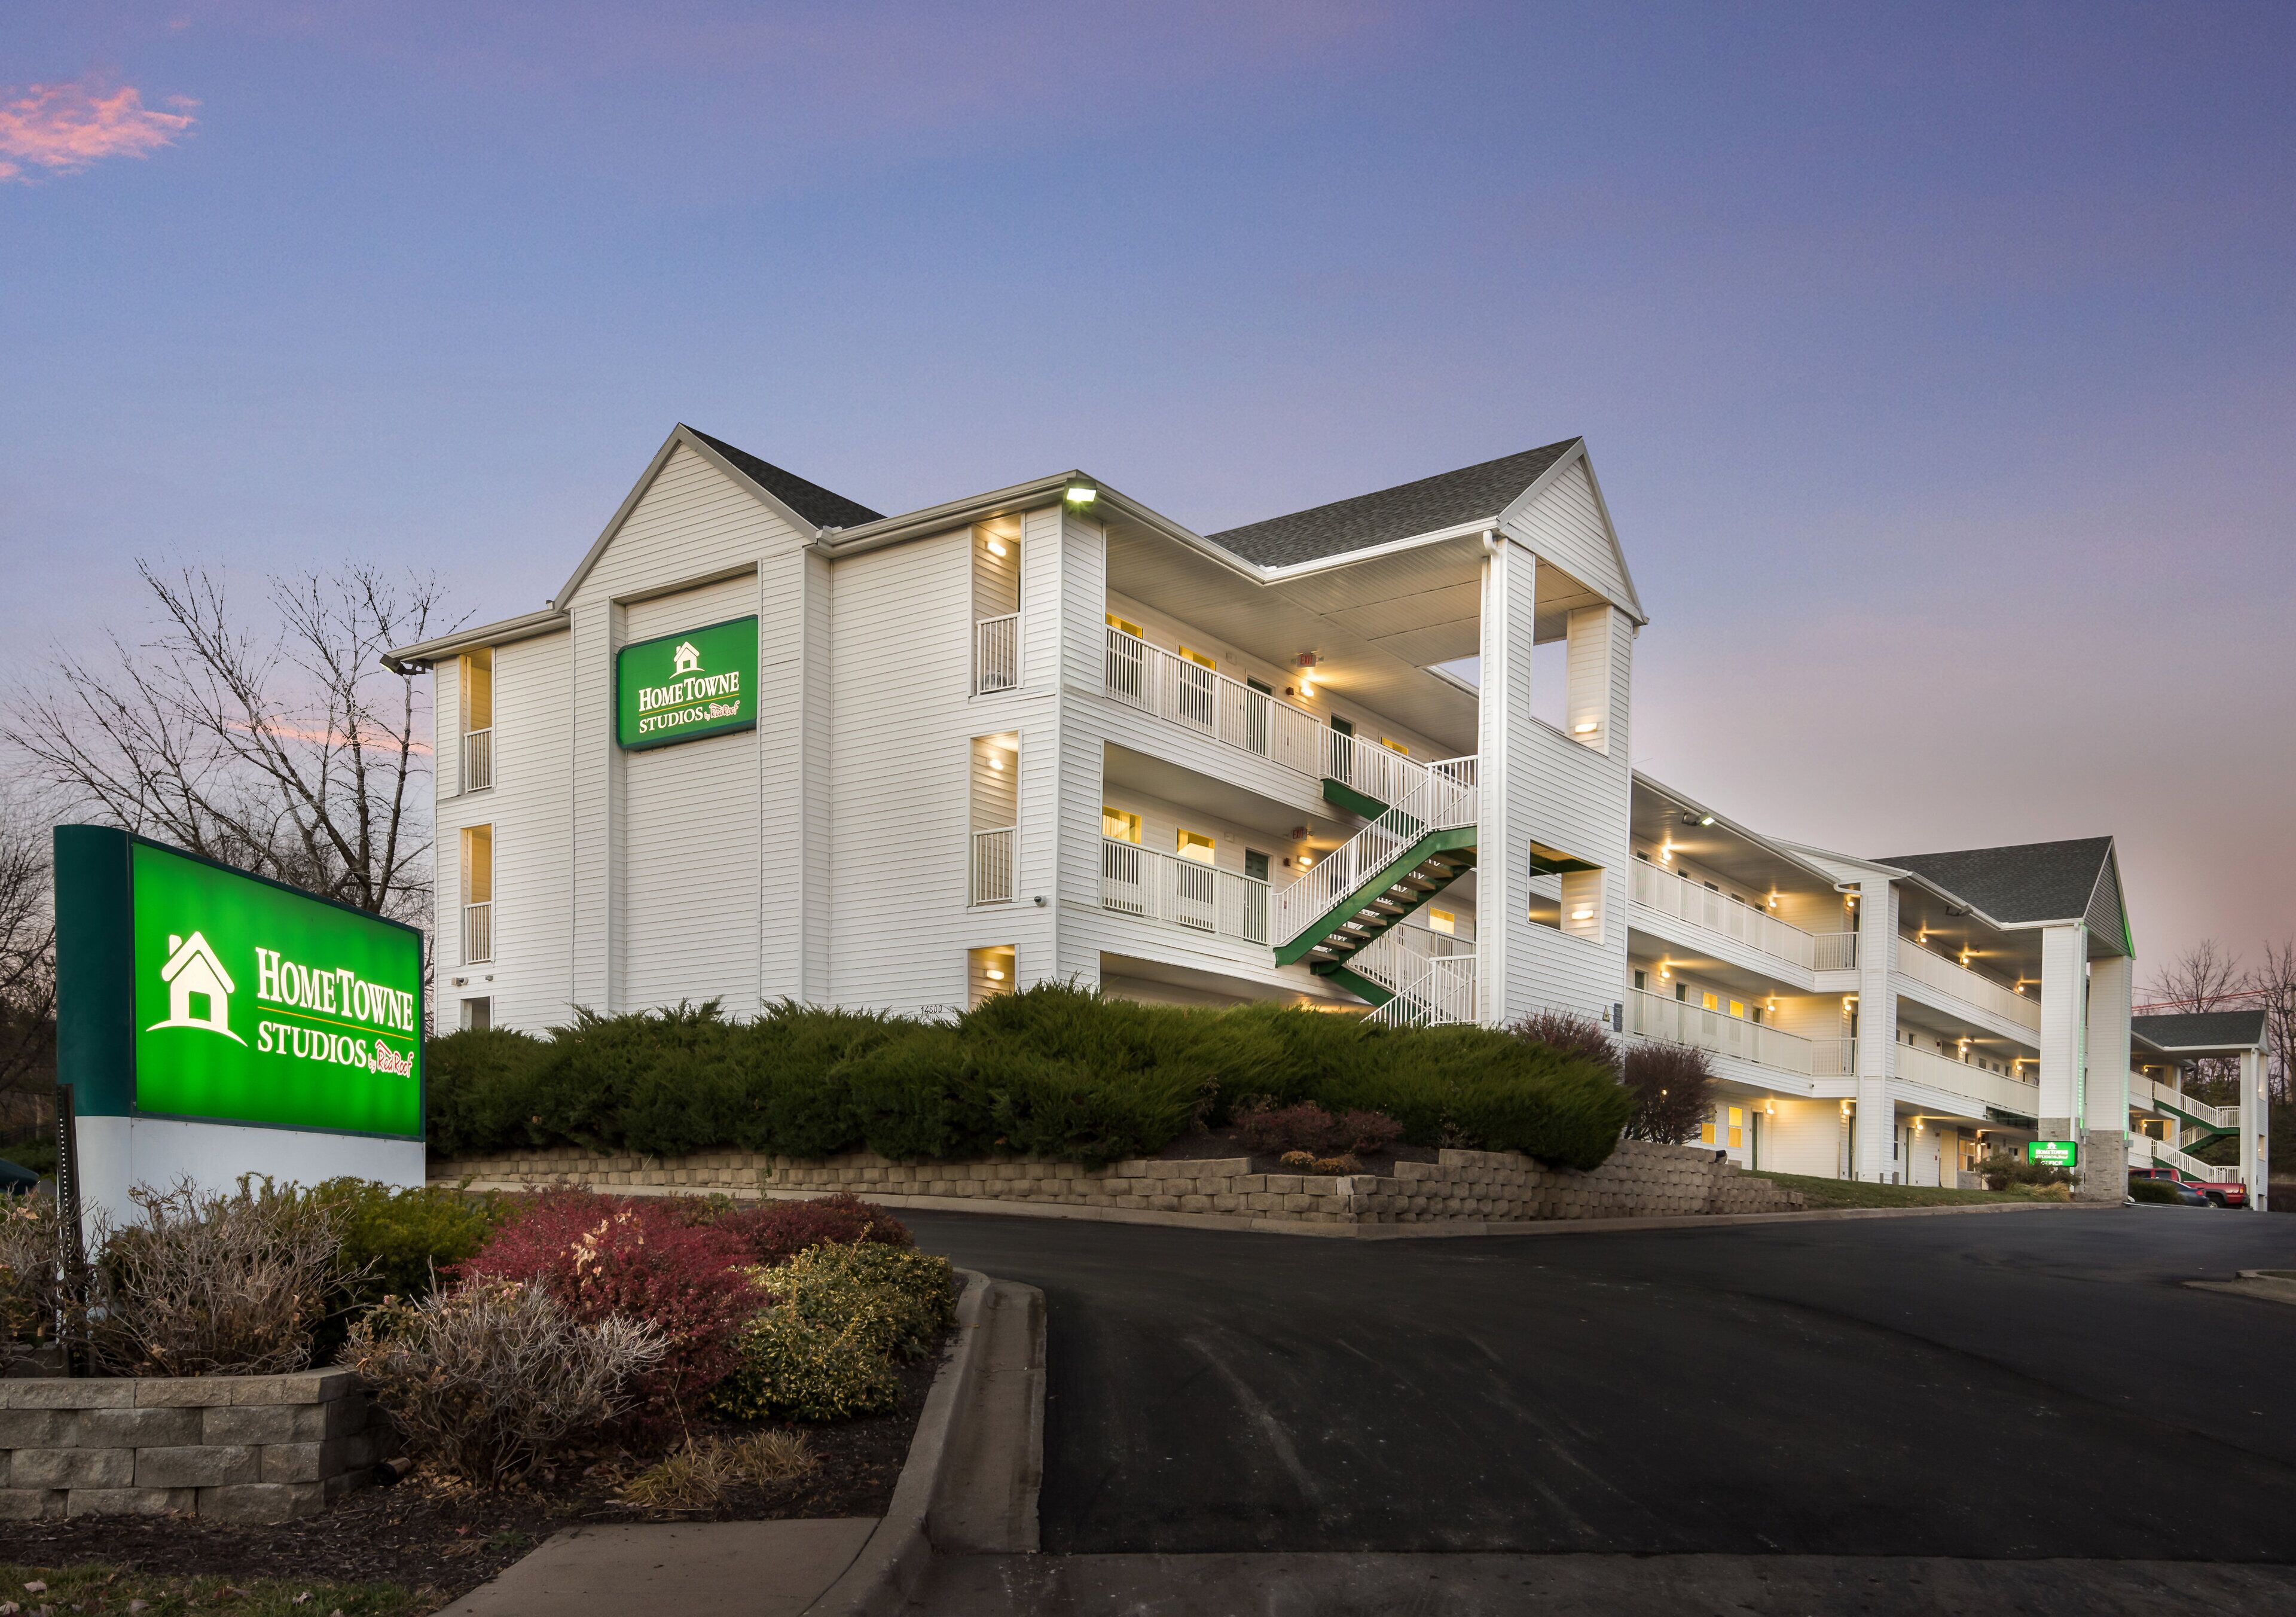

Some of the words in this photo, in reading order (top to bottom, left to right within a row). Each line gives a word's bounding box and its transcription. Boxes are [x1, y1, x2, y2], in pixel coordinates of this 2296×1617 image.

[1300, 655, 1314, 665] EXIT
[639, 671, 740, 712] HOMETOWNE
[639, 706, 703, 733] STUDIOS
[704, 711, 710, 721] by
[1293, 826, 1305, 840] EXIT
[255, 947, 414, 1032] HOMETOWNE
[258, 1020, 367, 1067] STUDIOS
[368, 1052, 377, 1074] by
